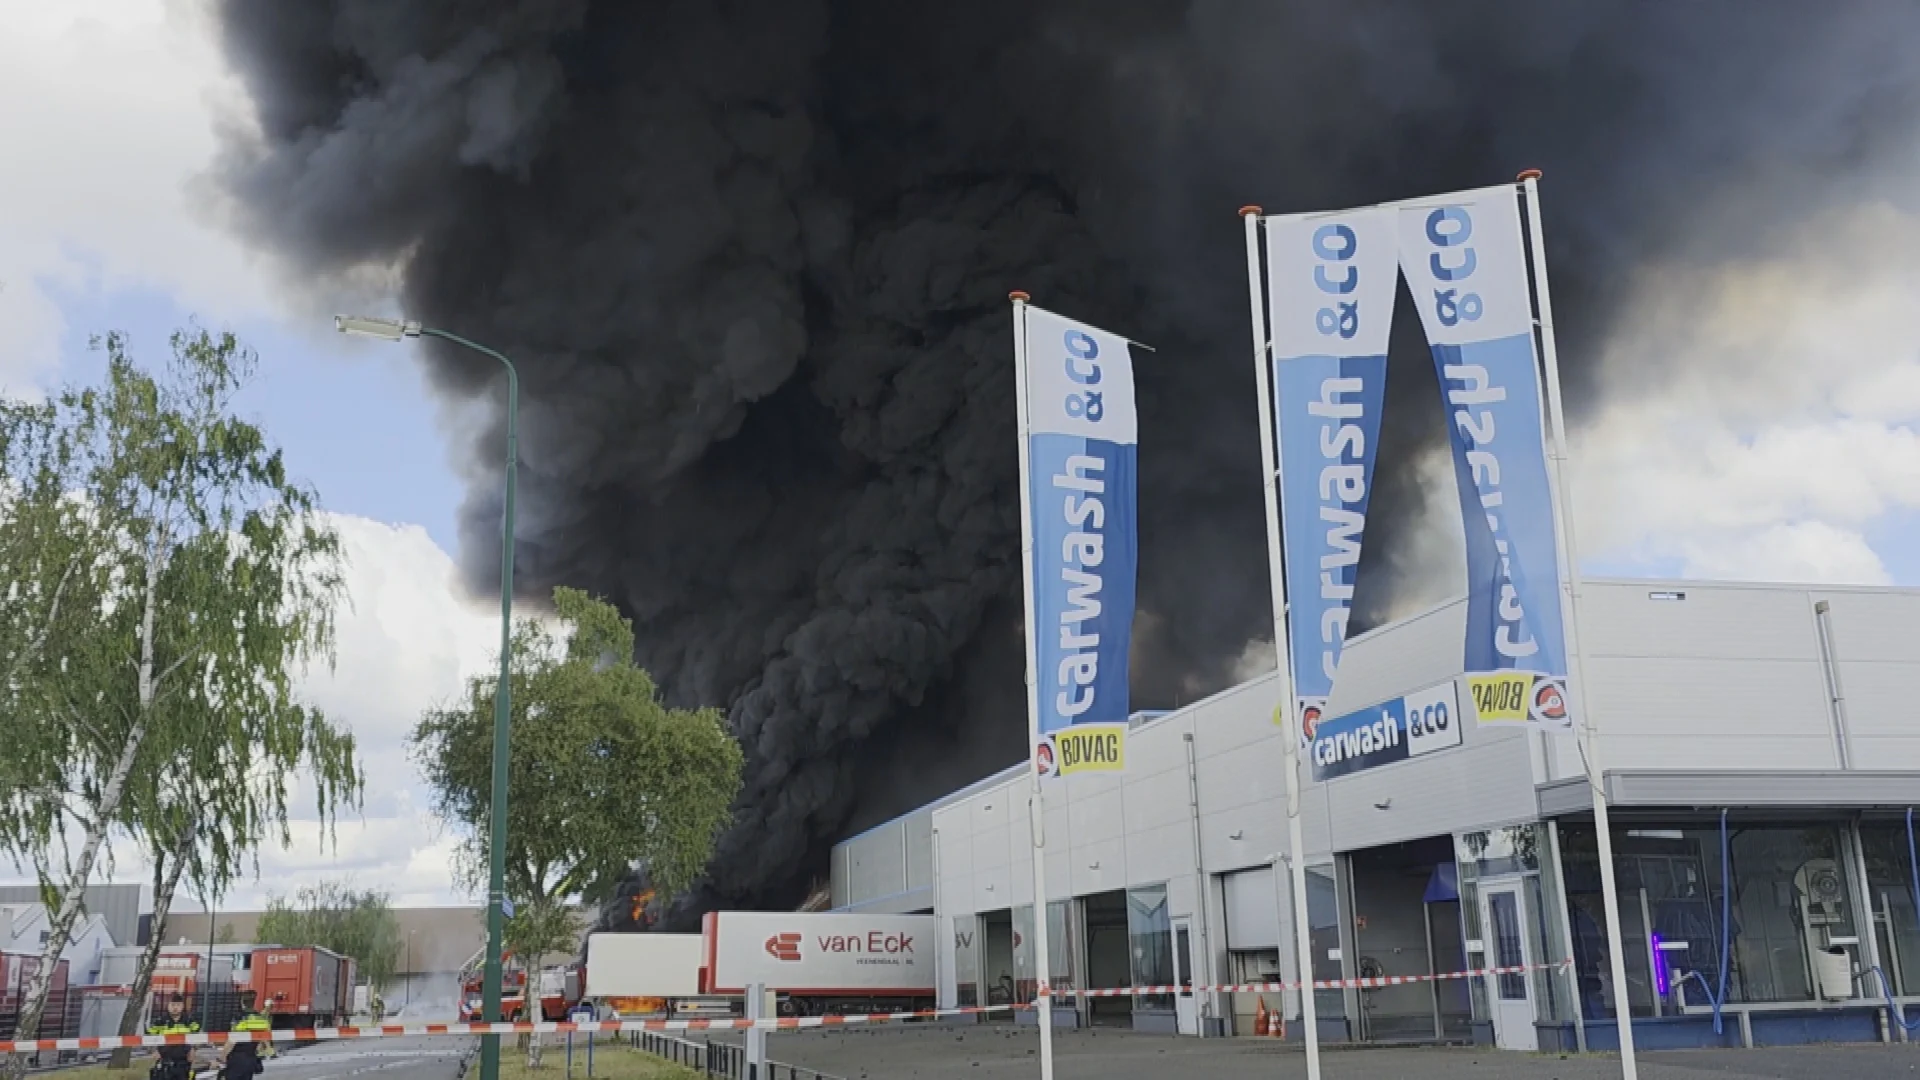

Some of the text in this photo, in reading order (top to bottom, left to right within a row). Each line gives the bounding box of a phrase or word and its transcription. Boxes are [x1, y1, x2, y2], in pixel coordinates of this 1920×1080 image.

[1052, 454, 1105, 718] carwash
[1061, 734, 1118, 767] BOVAG
[1314, 709, 1399, 767] carwash
[817, 931, 915, 954] van Eck
